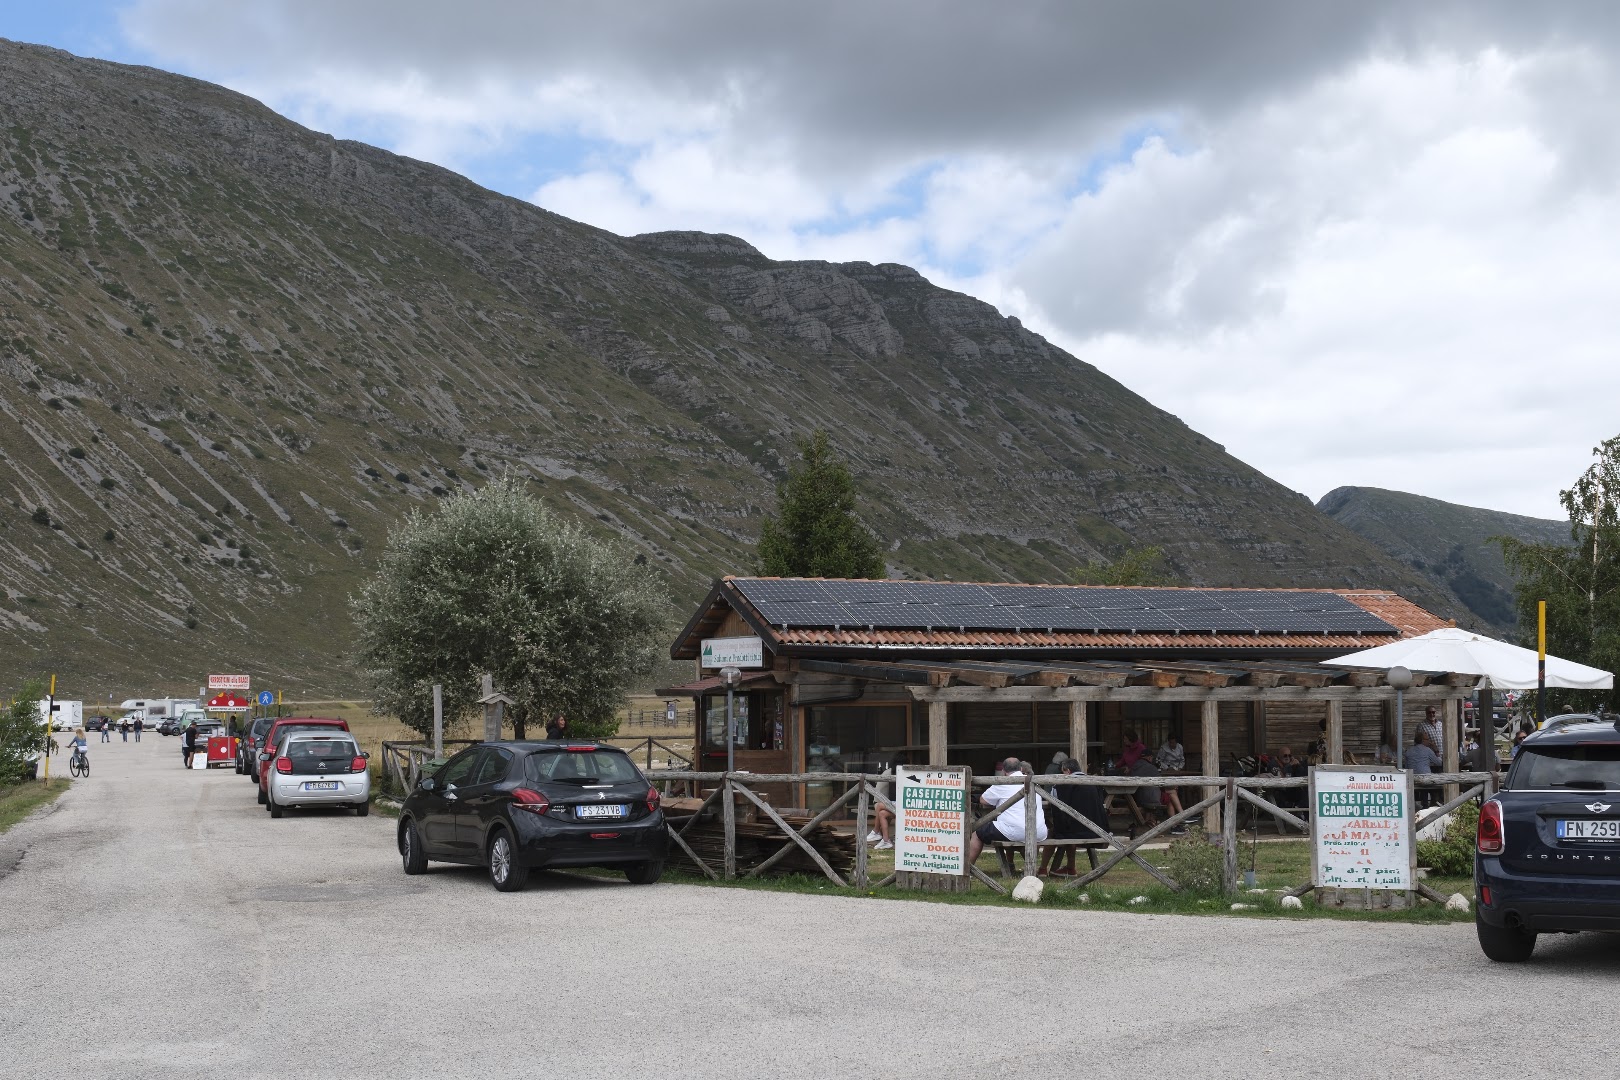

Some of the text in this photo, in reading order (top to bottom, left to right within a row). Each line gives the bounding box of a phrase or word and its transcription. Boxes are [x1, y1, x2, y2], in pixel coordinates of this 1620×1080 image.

[906, 788, 963, 801] CASEIFICIO
[1322, 792, 1399, 805] CASEIFICIO
[582, 805, 621, 815] FS 231VB
[905, 799, 962, 811] CAMPO FELICE
[1322, 804, 1399, 817] CAMPO FELICE
[905, 810, 961, 820] MOZZARELLE
[904, 819, 961, 830] FORMAGGI
[1566, 822, 1620, 836] FN 259
[922, 861, 960, 869] Artigianali
